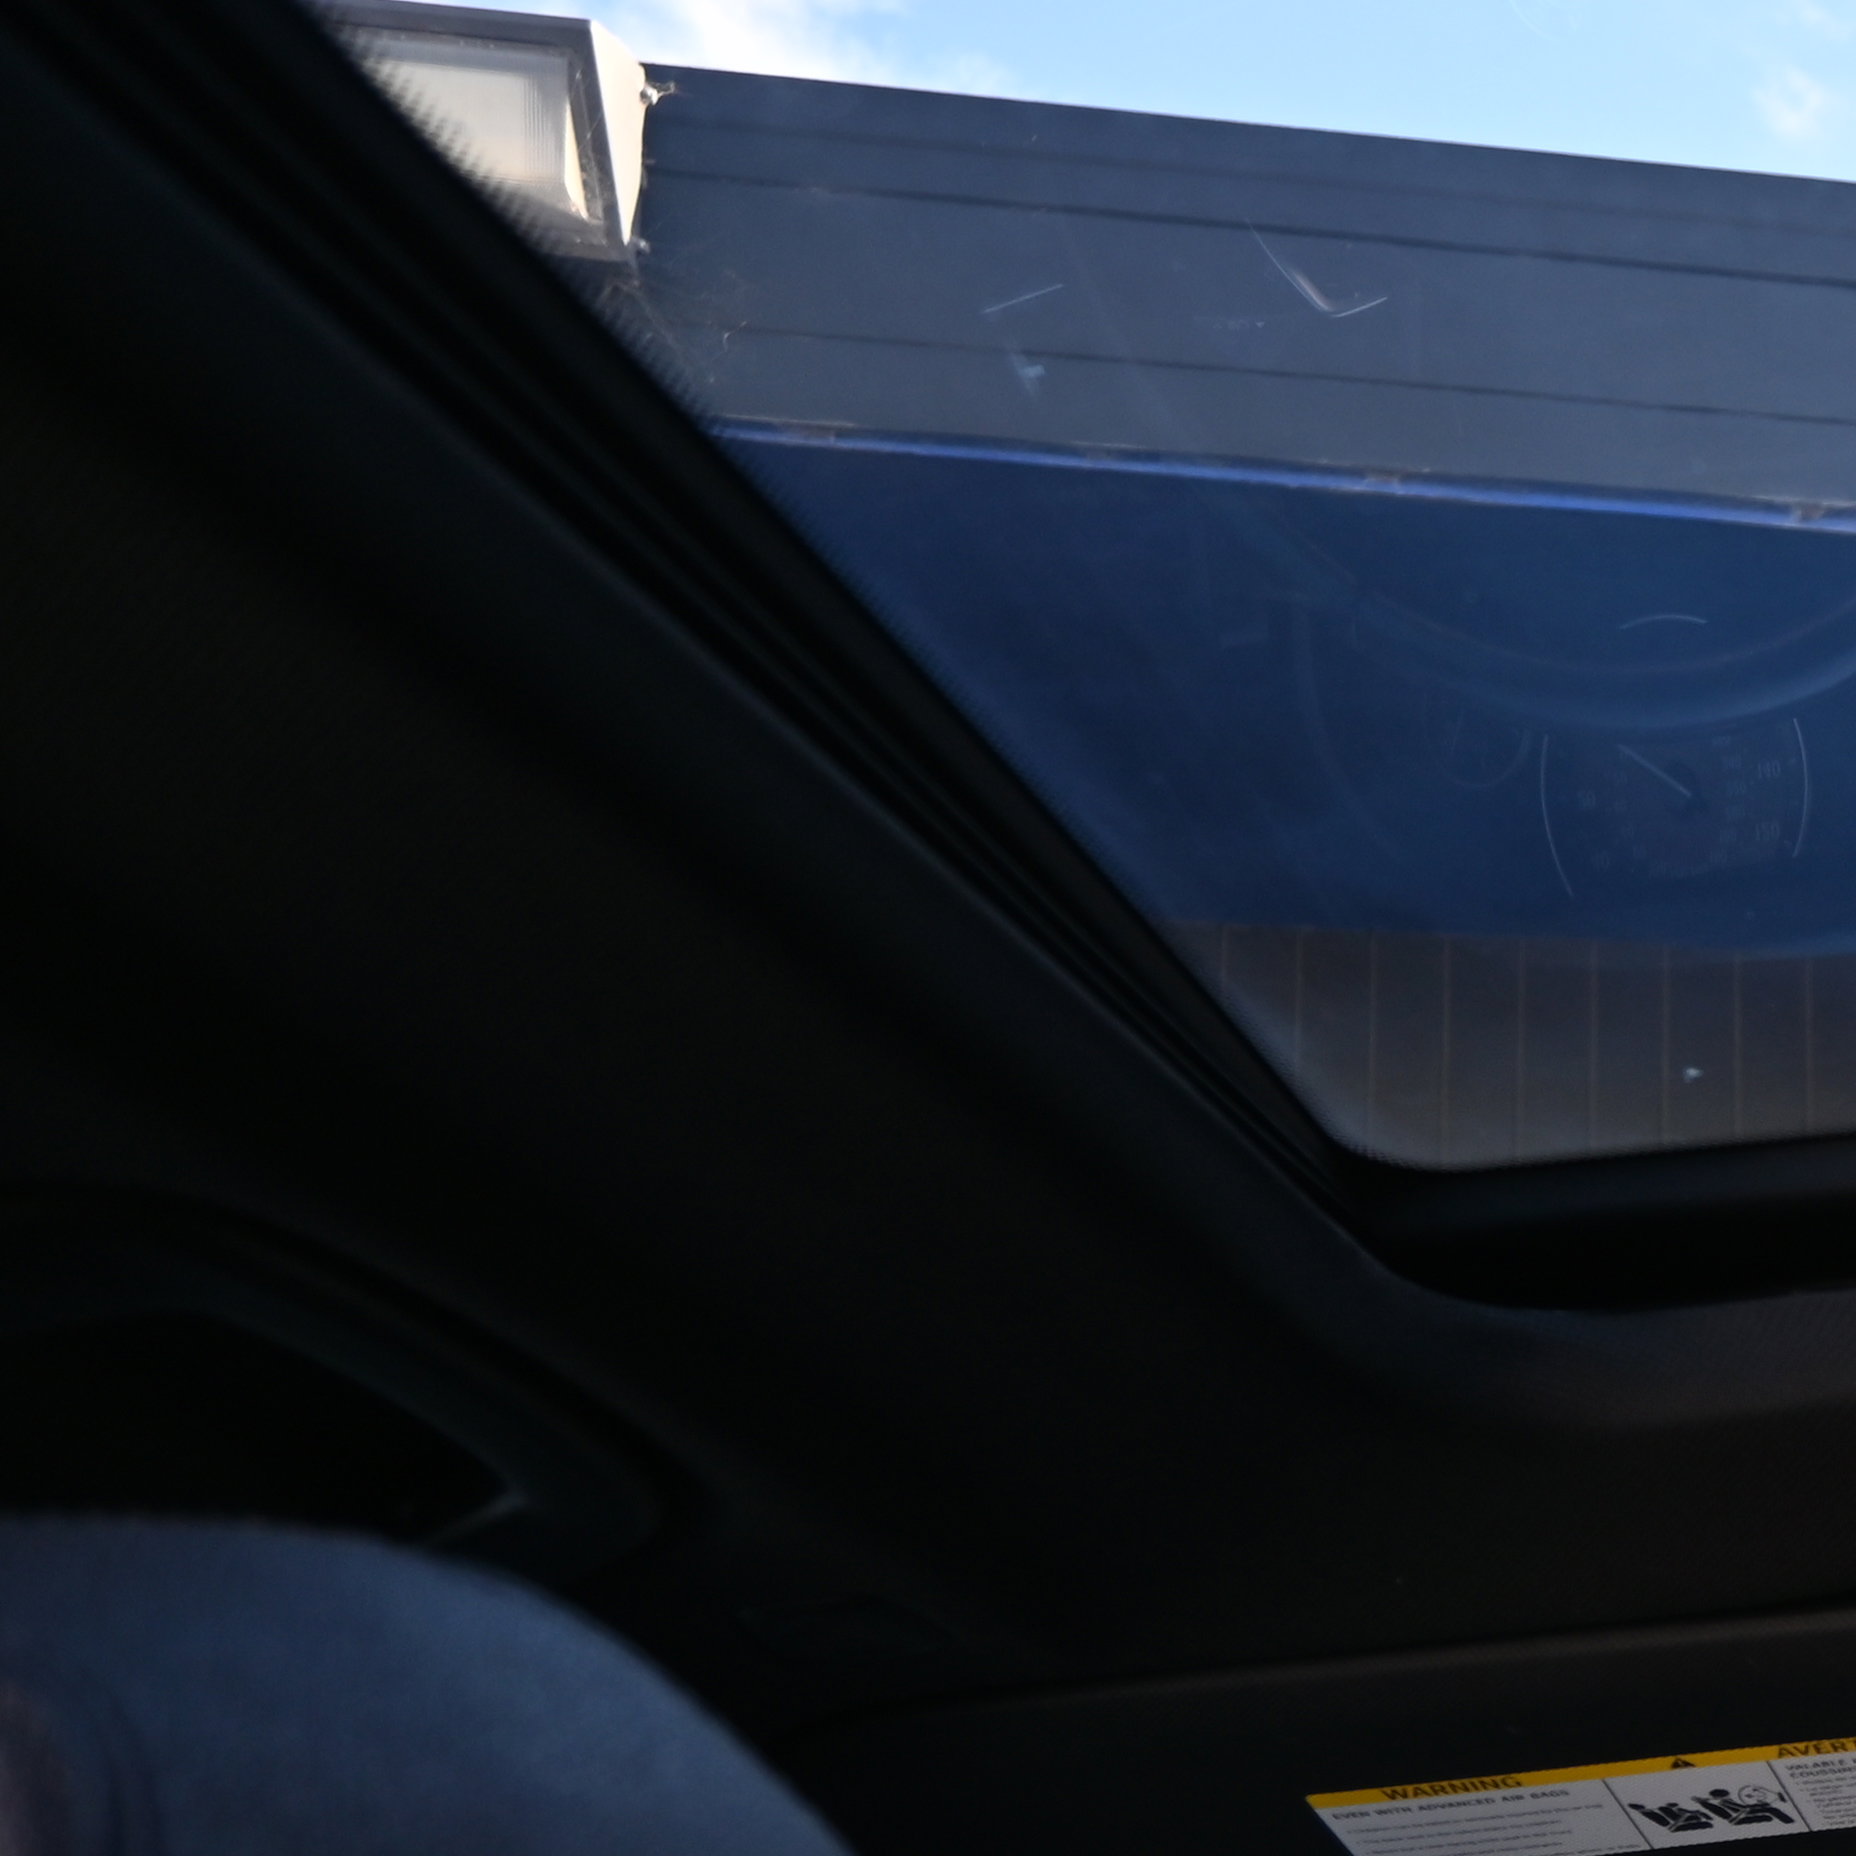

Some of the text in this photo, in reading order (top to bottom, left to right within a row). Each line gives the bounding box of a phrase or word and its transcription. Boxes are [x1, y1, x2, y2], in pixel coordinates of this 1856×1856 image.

[1381, 1775, 1523, 1800] WARNING
[1332, 1809, 1370, 1821] EVEN
[1375, 1804, 1413, 1816] WITH
[1418, 1797, 1496, 1812] ADVANCED
[1530, 1788, 1570, 1800] BAGS
